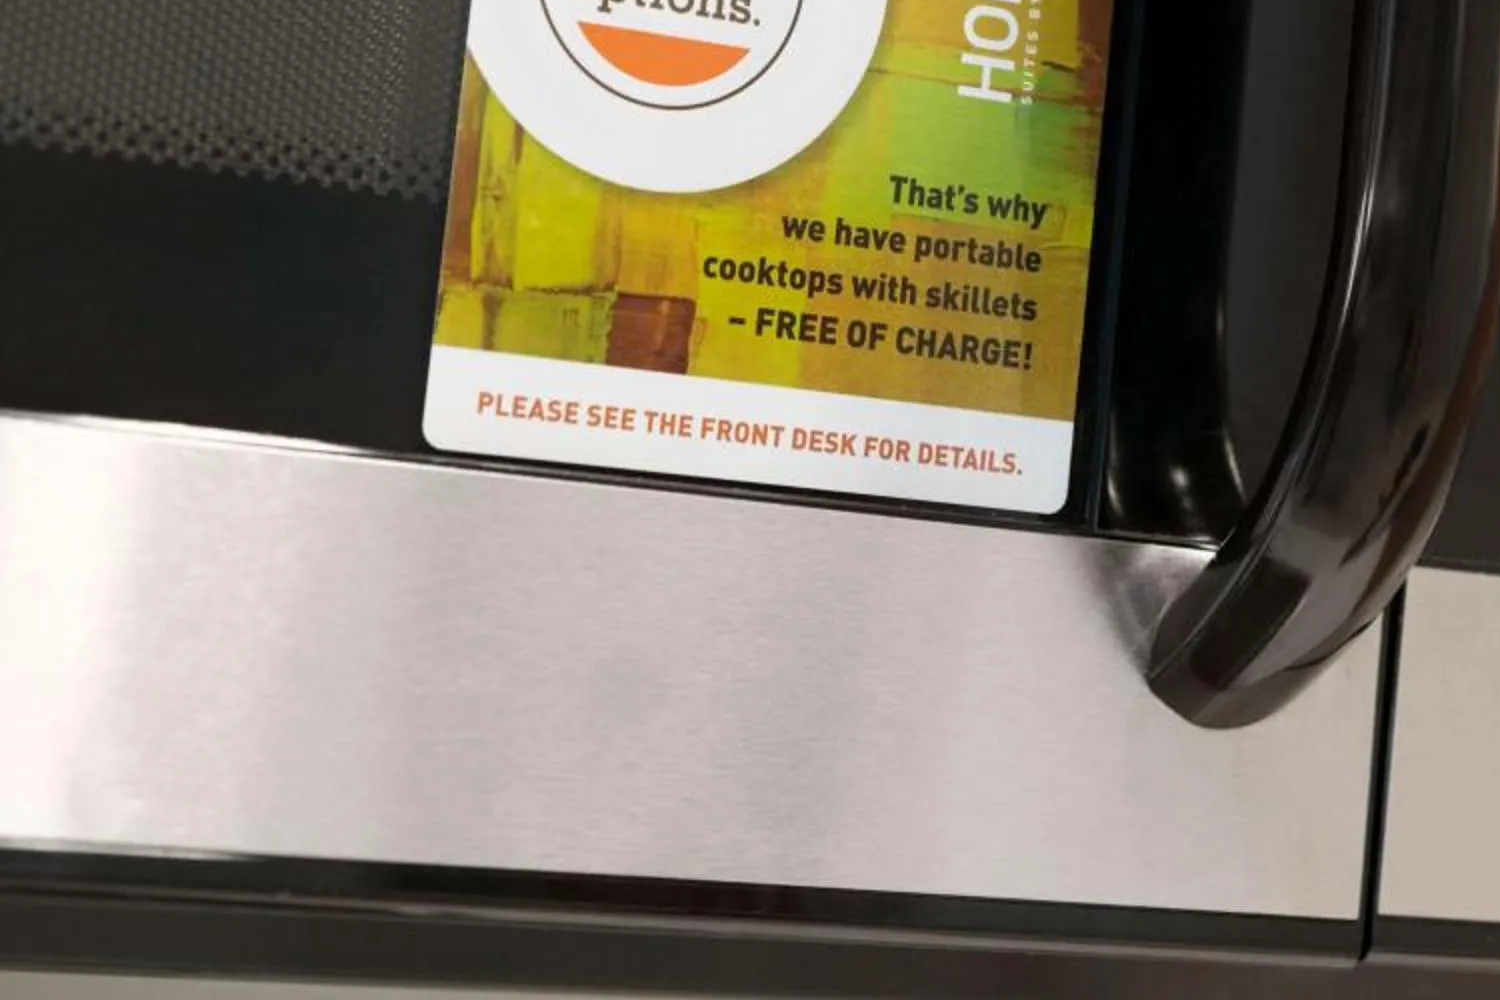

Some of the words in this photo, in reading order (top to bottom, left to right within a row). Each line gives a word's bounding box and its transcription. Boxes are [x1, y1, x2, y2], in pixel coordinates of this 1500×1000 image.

[1020, 31, 1040, 105] SUITES
[890, 175, 978, 215] That's
[987, 195, 1049, 230] why
[782, 215, 825, 243] we
[834, 217, 906, 254] have
[915, 234, 1043, 273] portable
[703, 254, 843, 298] cooktops
[852, 270, 917, 305] with
[925, 282, 1038, 322] skillets
[755, 307, 839, 344] FREE
[847, 320, 888, 351] OF
[895, 327, 1034, 371] CHARGE!
[476, 391, 580, 424] PLEASE
[585, 405, 636, 432] SEE
[644, 411, 694, 437] THE
[700, 417, 784, 448] FRONT
[791, 428, 857, 457] DESK
[863, 437, 910, 464] FOR
[917, 442, 1024, 477] DETAILS.
